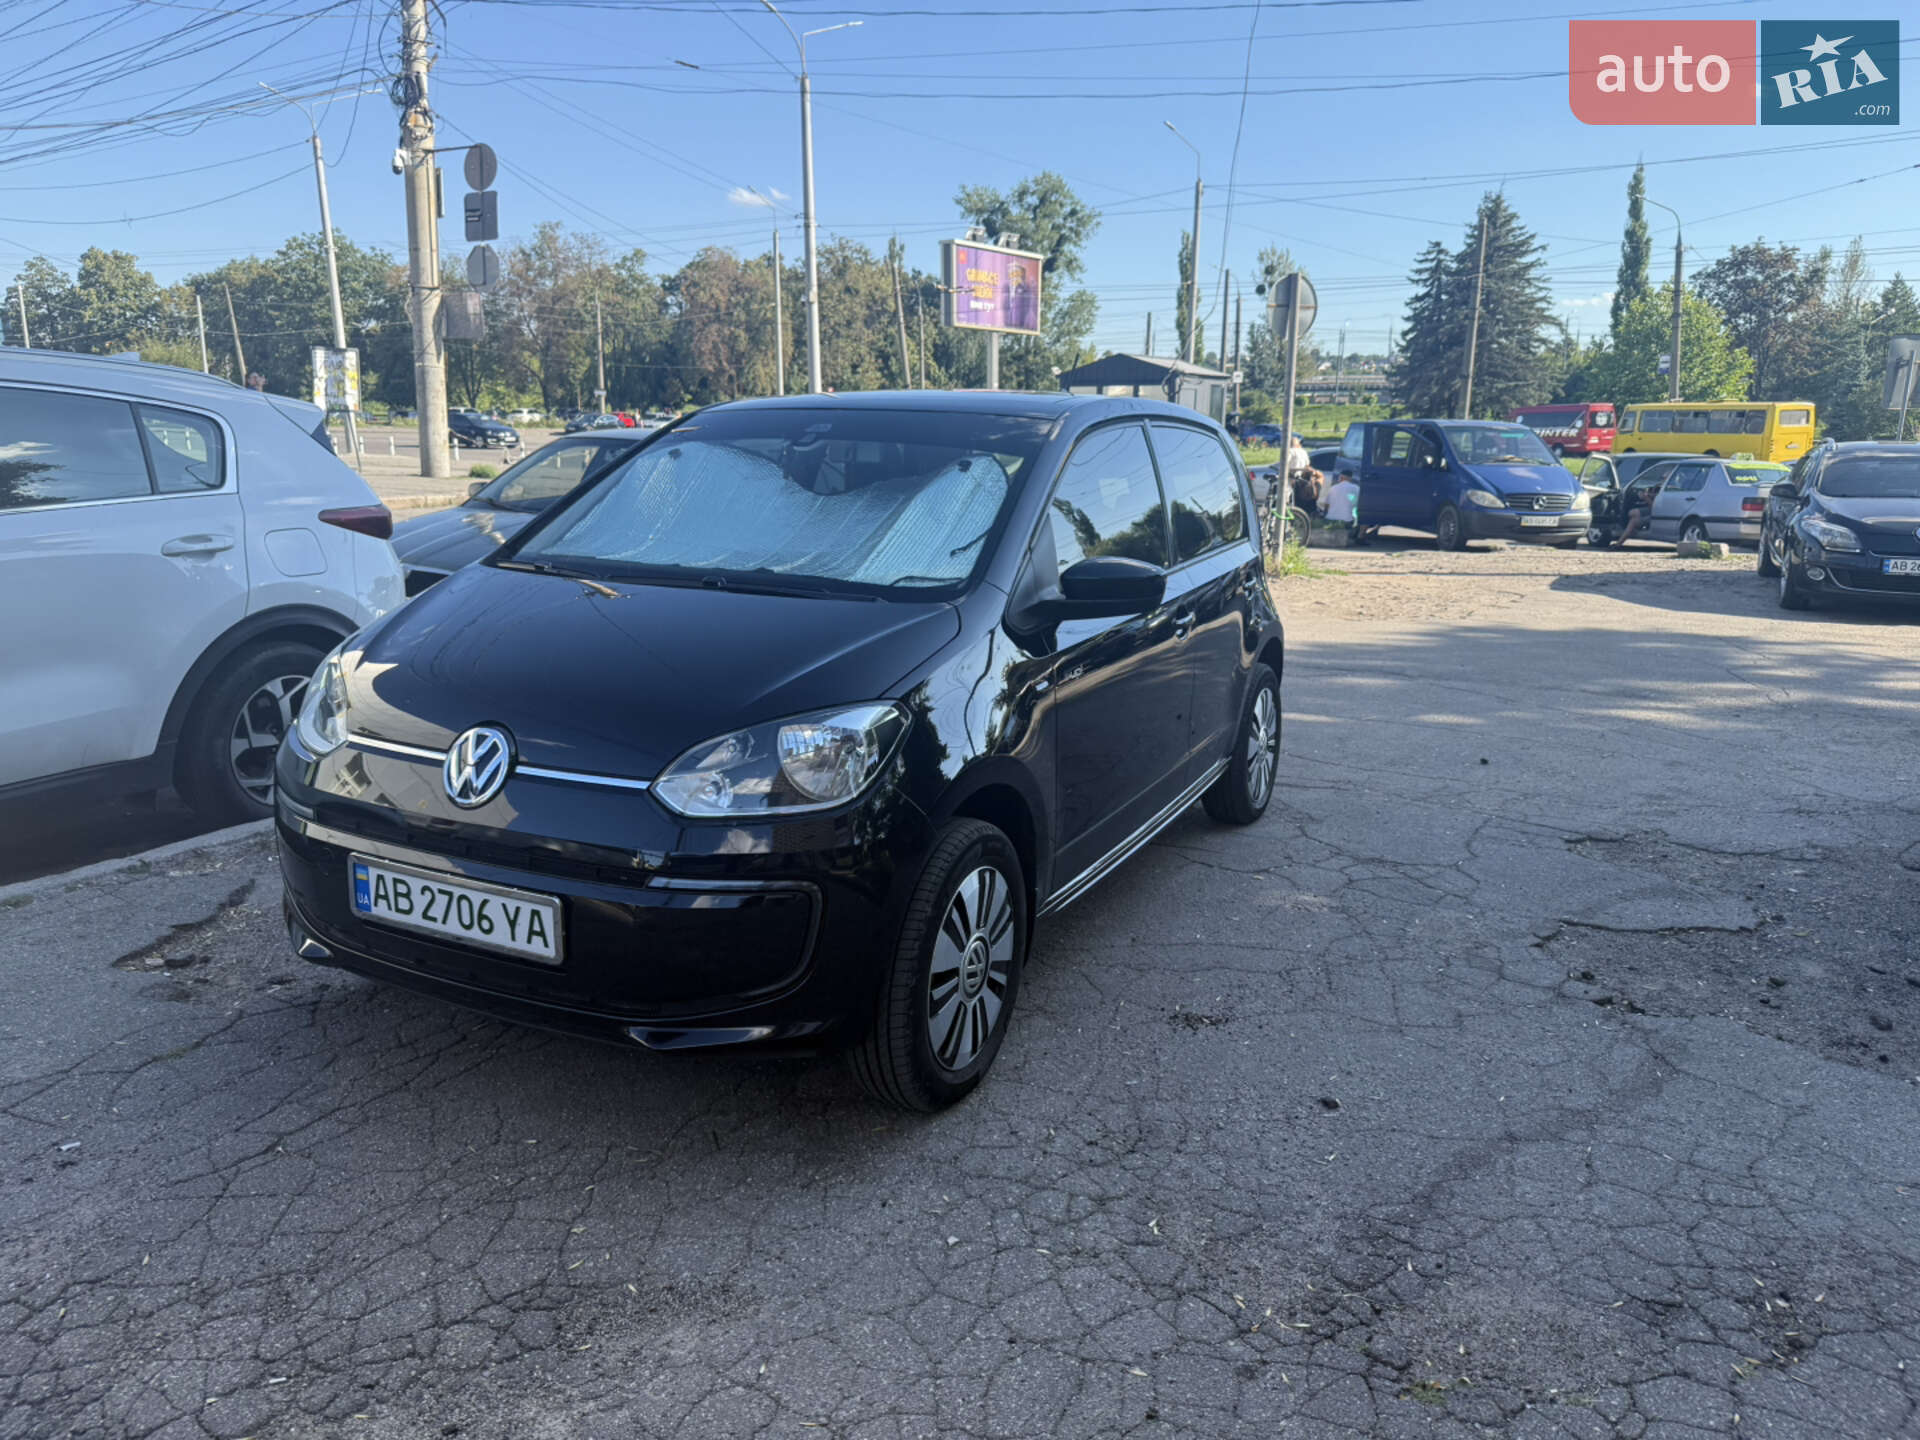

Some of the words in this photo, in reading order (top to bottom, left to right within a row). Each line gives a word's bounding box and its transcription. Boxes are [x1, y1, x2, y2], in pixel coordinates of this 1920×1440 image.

[1891, 560, 1908, 571] AB
[357, 892, 370, 905] UA
[373, 873, 414, 916] AB
[420, 885, 494, 935] 2706
[501, 902, 549, 949] YA
